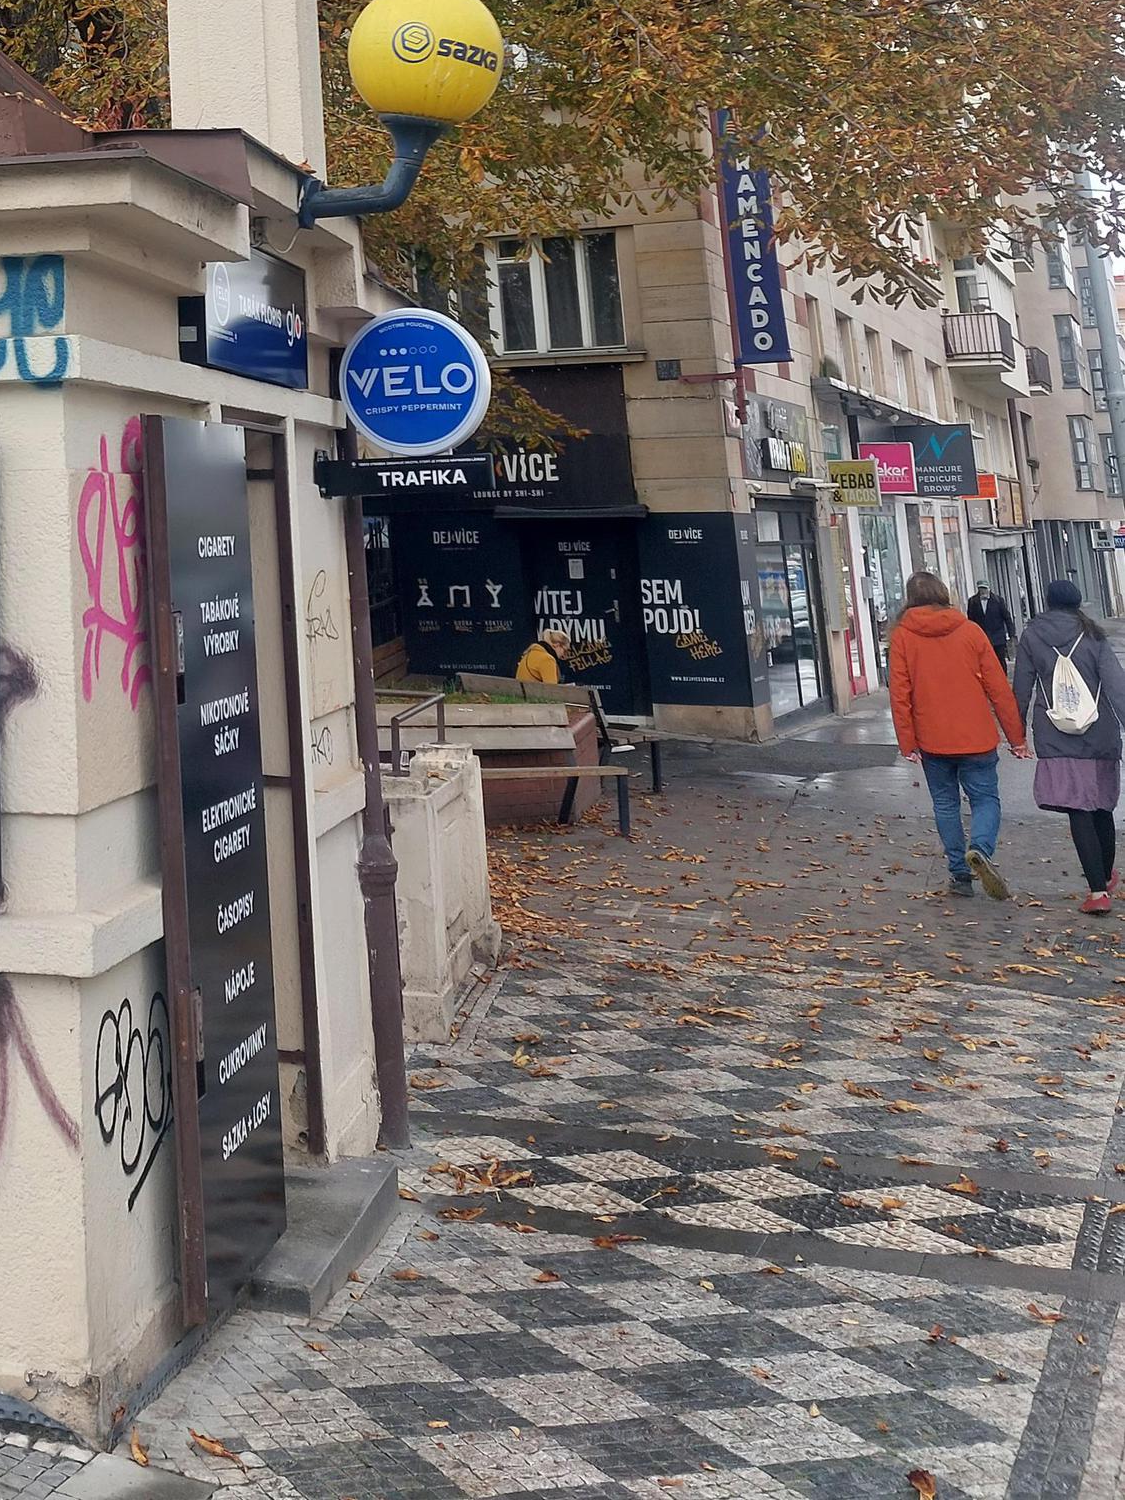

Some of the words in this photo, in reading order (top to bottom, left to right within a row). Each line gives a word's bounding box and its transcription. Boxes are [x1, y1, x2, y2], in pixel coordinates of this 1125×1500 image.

[238, 294, 260, 322] TABÁK
[261, 305, 282, 328] FLORIS
[286, 303, 302, 347] glo
[348, 362, 474, 399] VELO
[366, 405, 399, 415] CRISPY
[401, 403, 462, 413] PEPPERMINT
[378, 468, 468, 487] TRAFIKA
[830, 473, 875, 490] KEBAB
[916, 465, 963, 473] MANICURE
[918, 474, 963, 482] PEDICURE
[833, 489, 843, 502] &
[844, 489, 876, 501] TACOS
[924, 485, 957, 493] BROWS
[198, 535, 235, 558] CIGARETY
[534, 585, 583, 615] VÍTEJ
[640, 579, 683, 605] SEM
[200, 592, 240, 624] TABÁKOVÉ
[643, 605, 700, 634] POJĎ!
[203, 628, 239, 657] VÝROBKY
[689, 640, 724, 660] HERE
[200, 686, 250, 727] NIKOTONOVÉ
[214, 724, 240, 757] SÁČKY
[202, 782, 257, 833] ELEKTRONICKÉ
[213, 823, 251, 863] CIGARETY
[217, 890, 255, 935] ČASOPISY
[225, 961, 255, 1004] NÁPOJE
[218, 1023, 267, 1085] CUKROVINKY
[222, 1115, 248, 1162] SAZKA
[252, 1091, 272, 1130] LOSY
